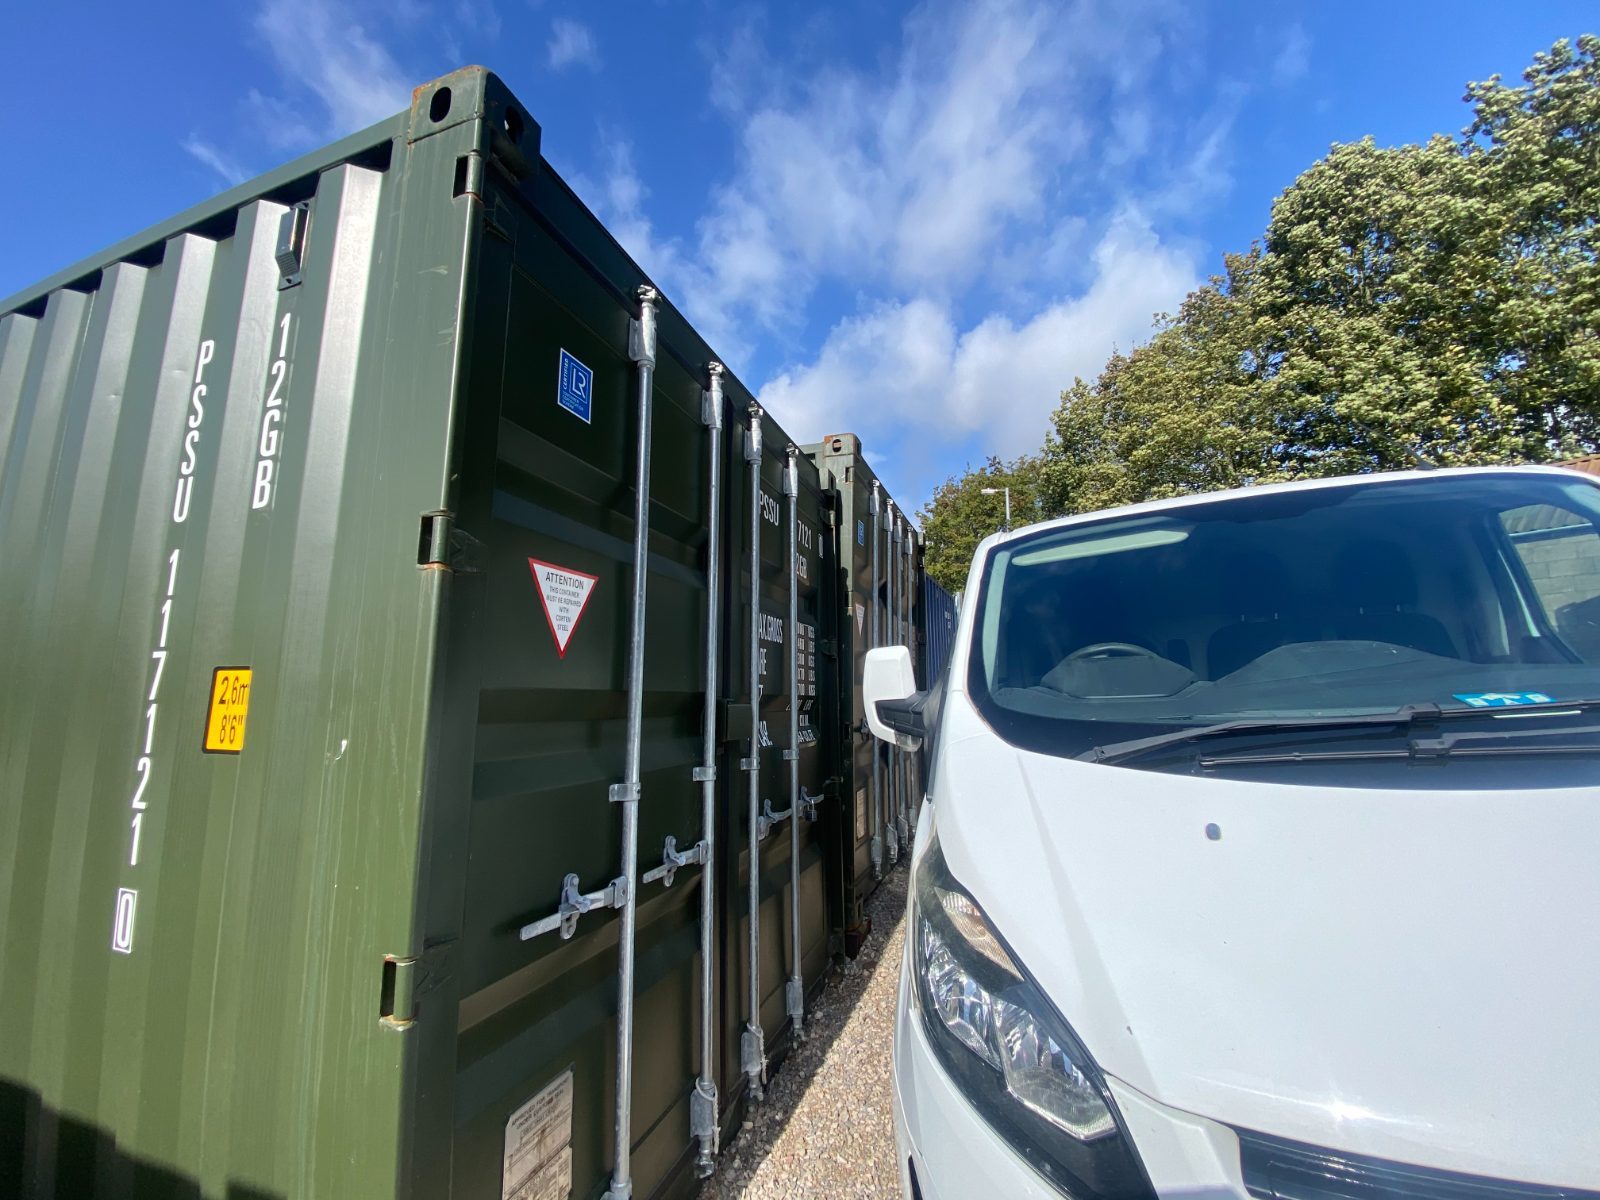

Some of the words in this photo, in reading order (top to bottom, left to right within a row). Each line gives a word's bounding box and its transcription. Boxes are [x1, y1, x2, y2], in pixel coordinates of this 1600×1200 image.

[572, 368, 586, 399] LR
[252, 312, 291, 509] 12GB
[173, 340, 215, 523] PSSU
[759, 489, 779, 527] PSSU
[797, 519, 812, 550] 7121
[796, 552, 808, 579] 2GB
[545, 571, 585, 590] ATTENTION
[549, 585, 559, 594] THIS
[559, 587, 580, 598] CONTAINER
[546, 594, 557, 603] MUST
[557, 596, 563, 604] BE
[563, 598, 582, 607] REPAIRED
[555, 614, 571, 623] CORTEN
[557, 624, 569, 632] STEEL
[131, 549, 180, 865] 117121
